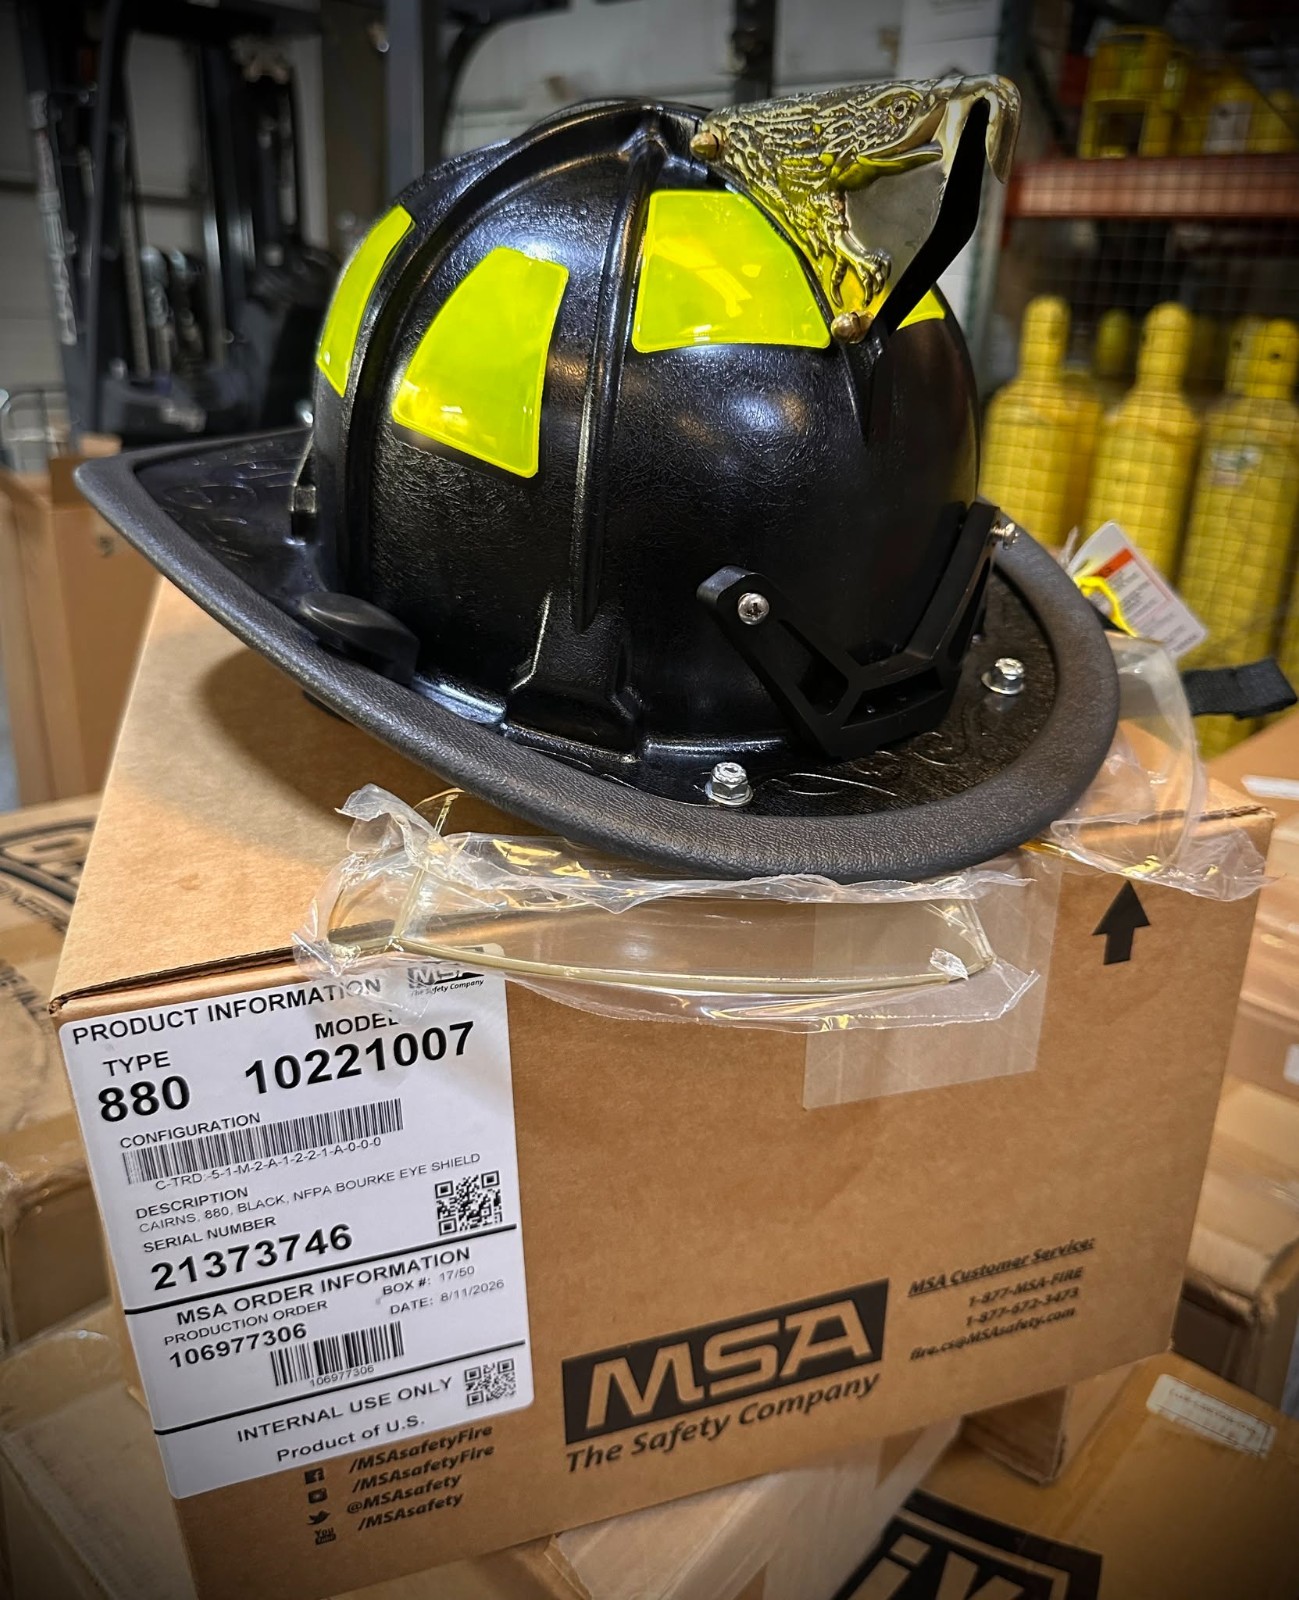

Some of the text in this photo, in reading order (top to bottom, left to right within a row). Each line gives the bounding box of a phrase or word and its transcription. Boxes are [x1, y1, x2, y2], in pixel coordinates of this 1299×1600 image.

[450, 979, 484, 991] Company
[72, 978, 381, 1045] PRODUCT INFORMATION
[103, 1051, 171, 1077] TYPE
[244, 1021, 475, 1095] 10221007
[98, 1075, 190, 1123] 880
[120, 1112, 261, 1149] CONFIGURATION
[136, 1187, 248, 1219] DESCRIPTION
[139, 1153, 481, 1233] CAIRNS, 880, BLACK, NFPA BOURKE EYE SHIELD
[143, 1216, 277, 1253] SERIAL NUMBER
[151, 1223, 353, 1291] 21373746
[177, 1247, 471, 1326] MSA ORDER INFORMATION
[382, 1280, 414, 1296] BOX
[439, 1265, 475, 1282] 17/50
[390, 1279, 505, 1315] DATE: 8/11/2026
[908, 1273, 947, 1297] MSA
[950, 1254, 1030, 1287] Customer
[164, 1300, 328, 1346] PRODUCTION ORDER
[169, 1322, 307, 1368] 106977306
[309, 1365, 374, 1387] 106977306
[585, 1299, 874, 1431] MSA
[237, 1376, 453, 1442] INTERNAL USE ONLY
[566, 1373, 880, 1473] The Safety Company
[277, 1415, 425, 1462] Product of U.S.
[349, 1425, 493, 1474] /MSAsafetyFire
[352, 1445, 495, 1493] /MSAsafetyFire
[346, 1474, 462, 1514] @MSAsafety
[358, 1493, 465, 1532] /MSAsafety
